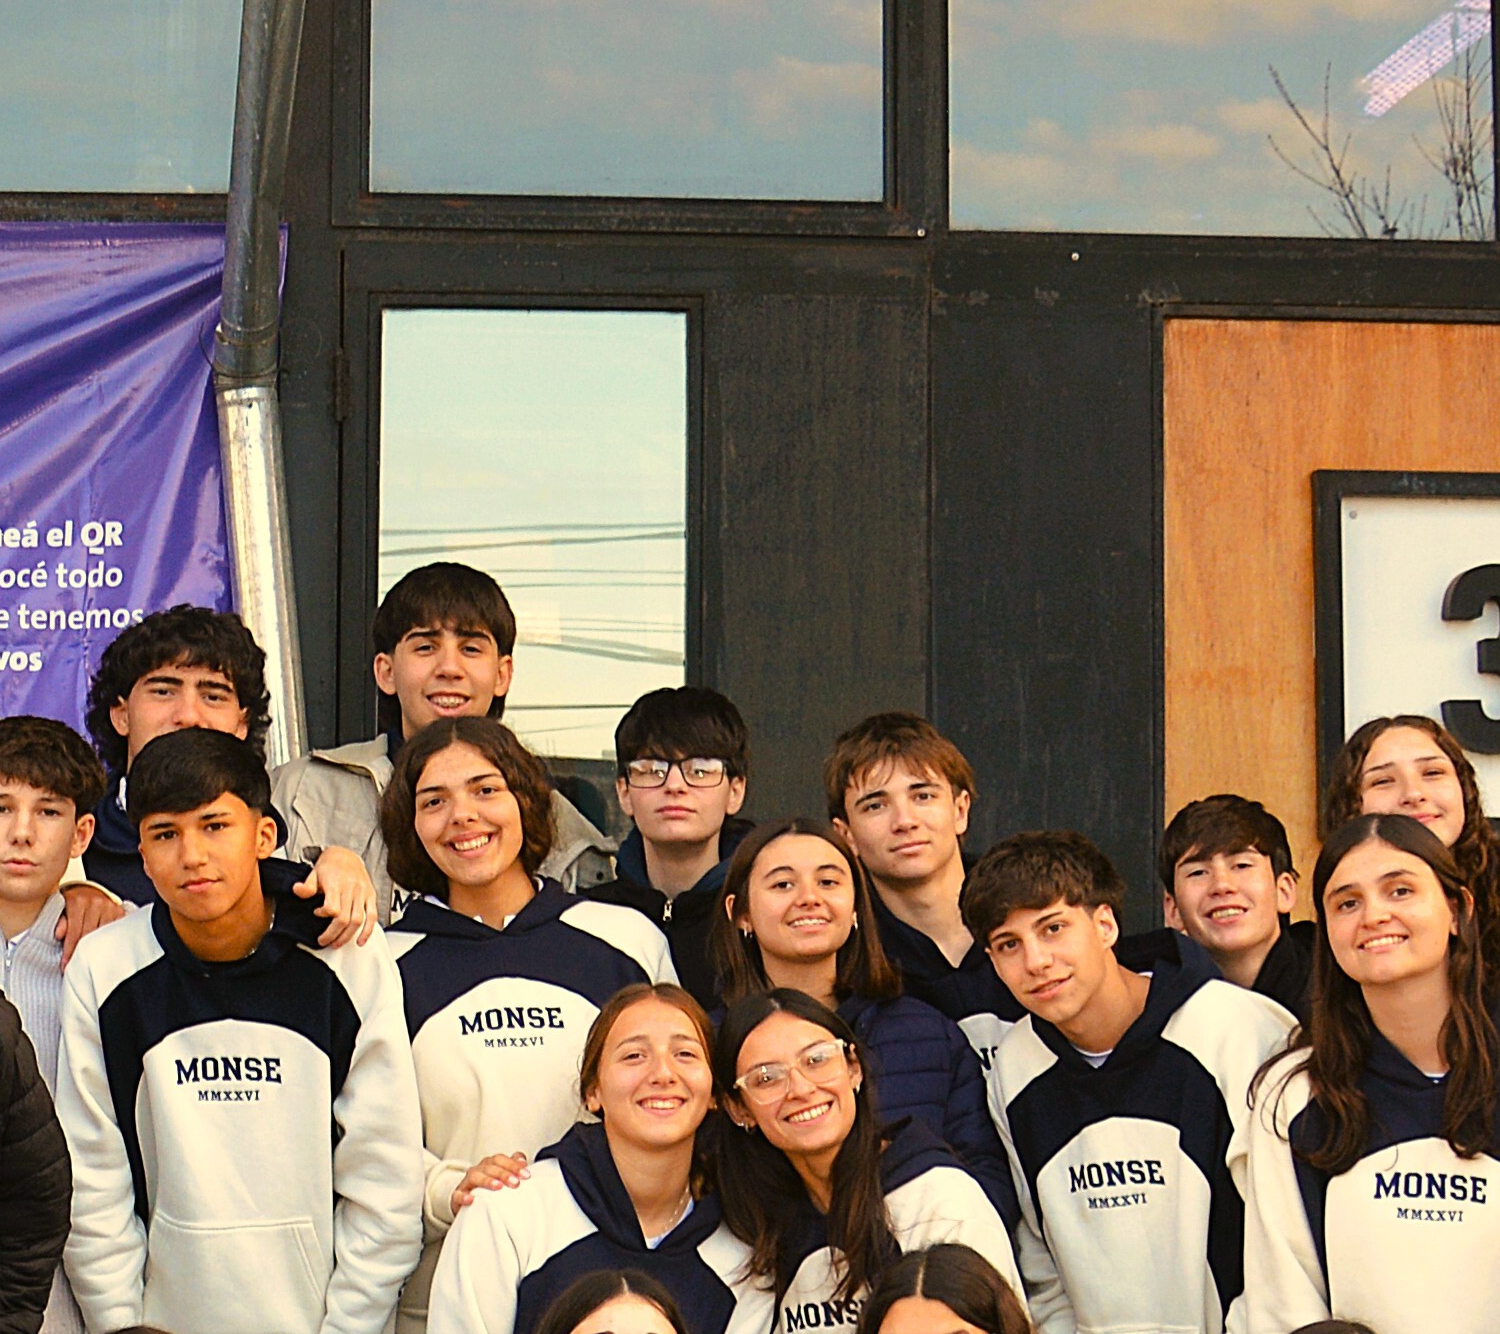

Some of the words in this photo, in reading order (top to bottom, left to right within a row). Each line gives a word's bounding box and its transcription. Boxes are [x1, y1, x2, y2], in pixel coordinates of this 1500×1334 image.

[46, 520, 73, 547] el
[80, 521, 124, 554] QR
[55, 561, 124, 589] todo
[18, 603, 144, 630] tenemos
[459, 1007, 565, 1035] MONSE
[484, 1036, 544, 1048] MMXXVI
[174, 1056, 282, 1085] MONSE
[198, 1089, 260, 1102] MMXXVI
[1069, 1159, 1166, 1194] MONSE
[1373, 1171, 1487, 1205] MONSE
[1087, 1192, 1148, 1209] MMXXVI
[1397, 1207, 1464, 1222] MMXXVI
[785, 1299, 864, 1334] MONS
